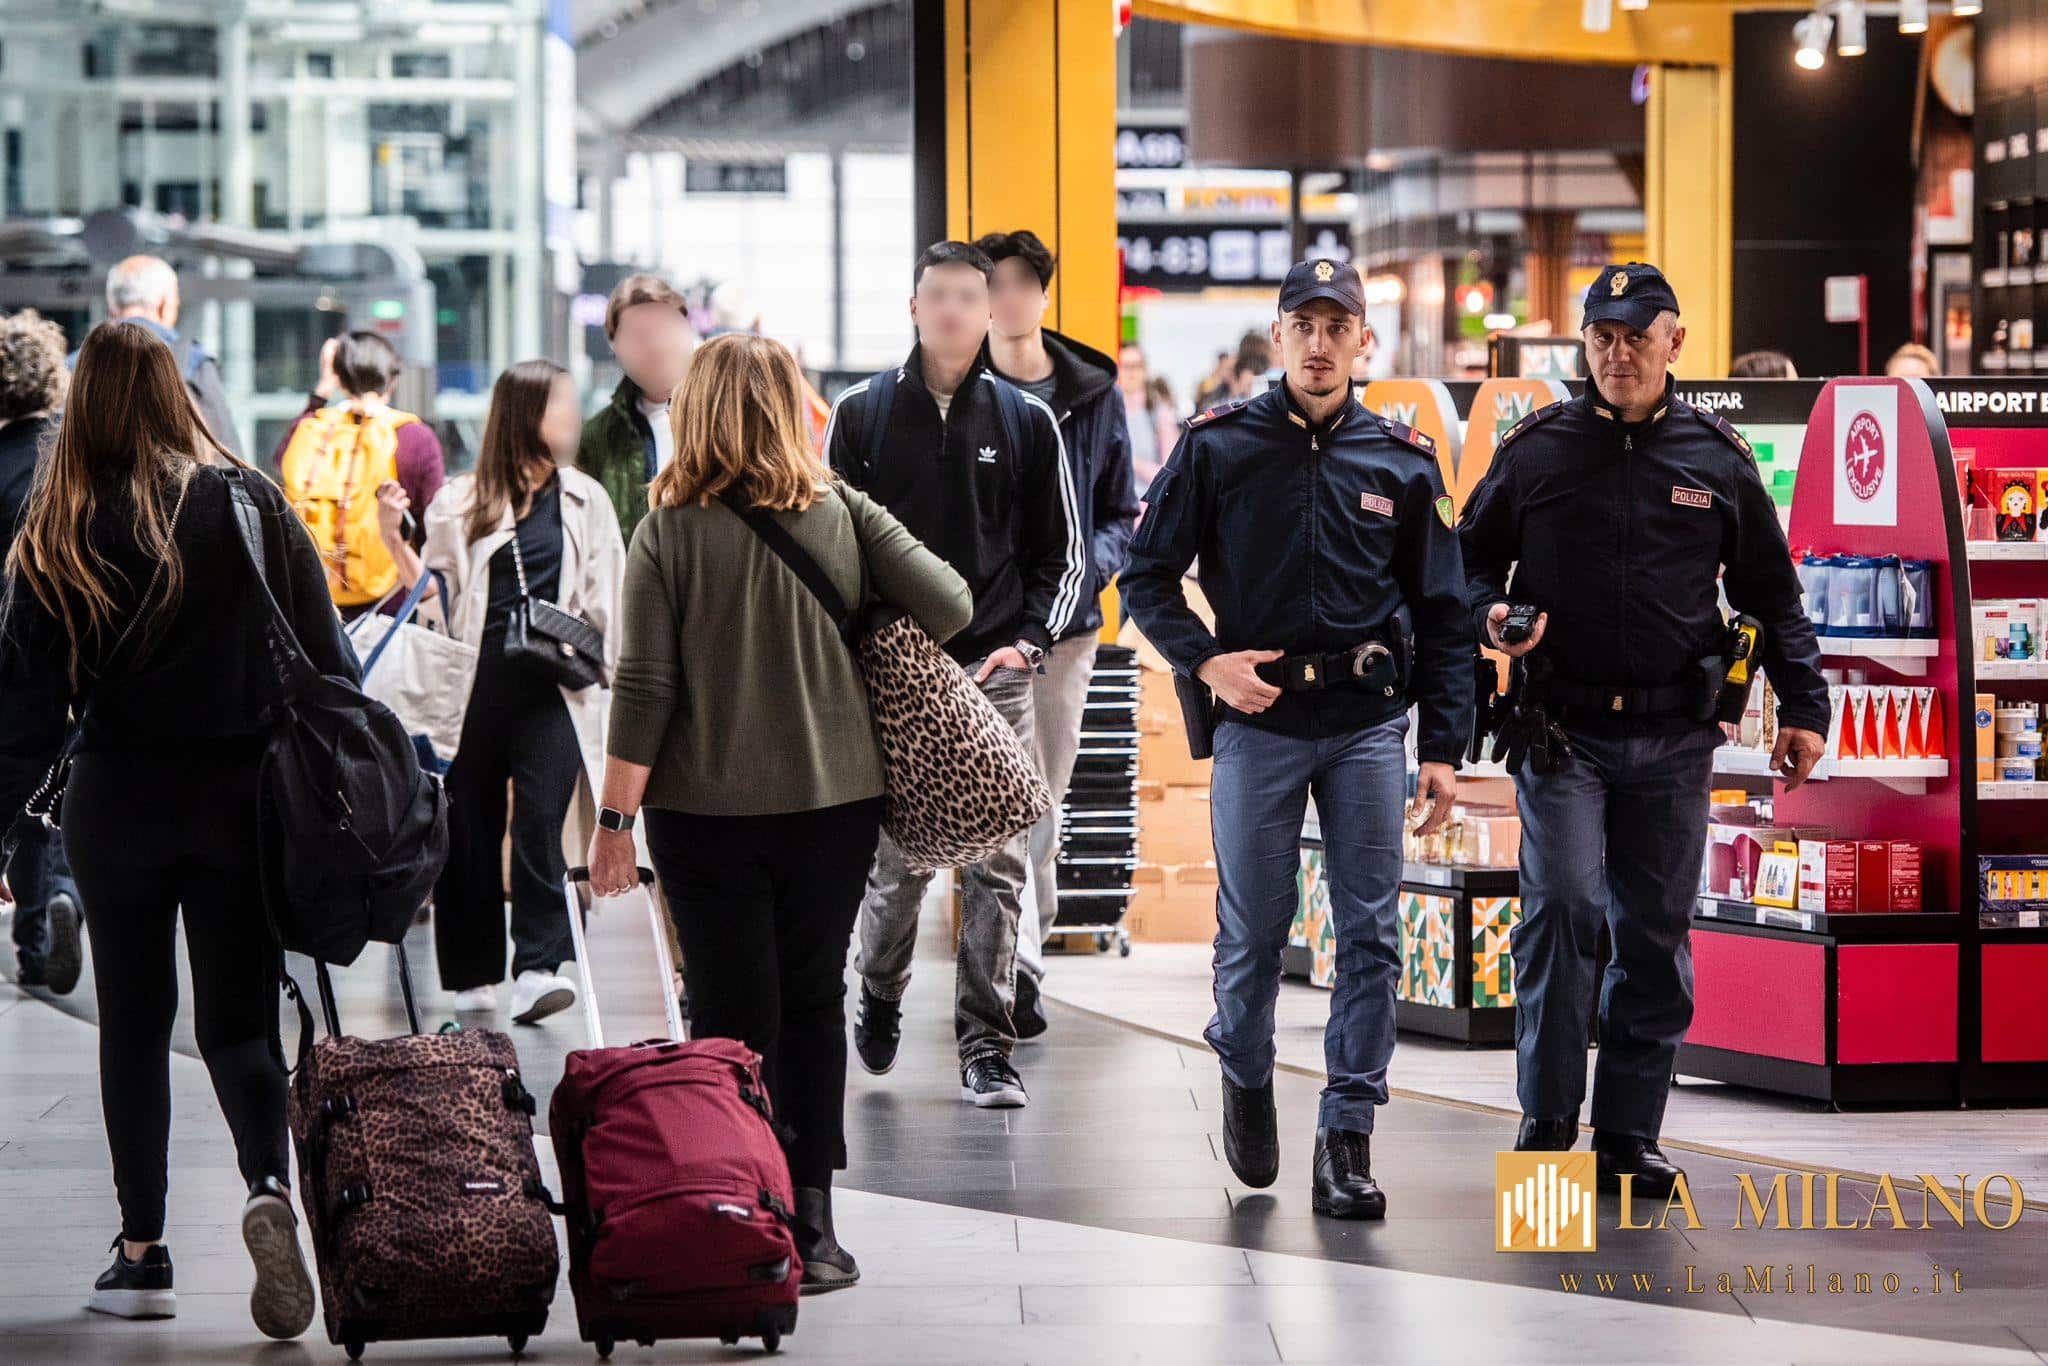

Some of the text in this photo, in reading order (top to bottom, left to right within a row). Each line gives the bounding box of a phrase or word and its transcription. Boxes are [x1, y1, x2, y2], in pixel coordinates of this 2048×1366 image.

[1936, 391, 2037, 413] AIRPORT
[1850, 417, 1881, 443] AIRPORT
[1847, 466, 1882, 498] EXCLUSIVE
[1674, 490, 1708, 505] POLIZIA
